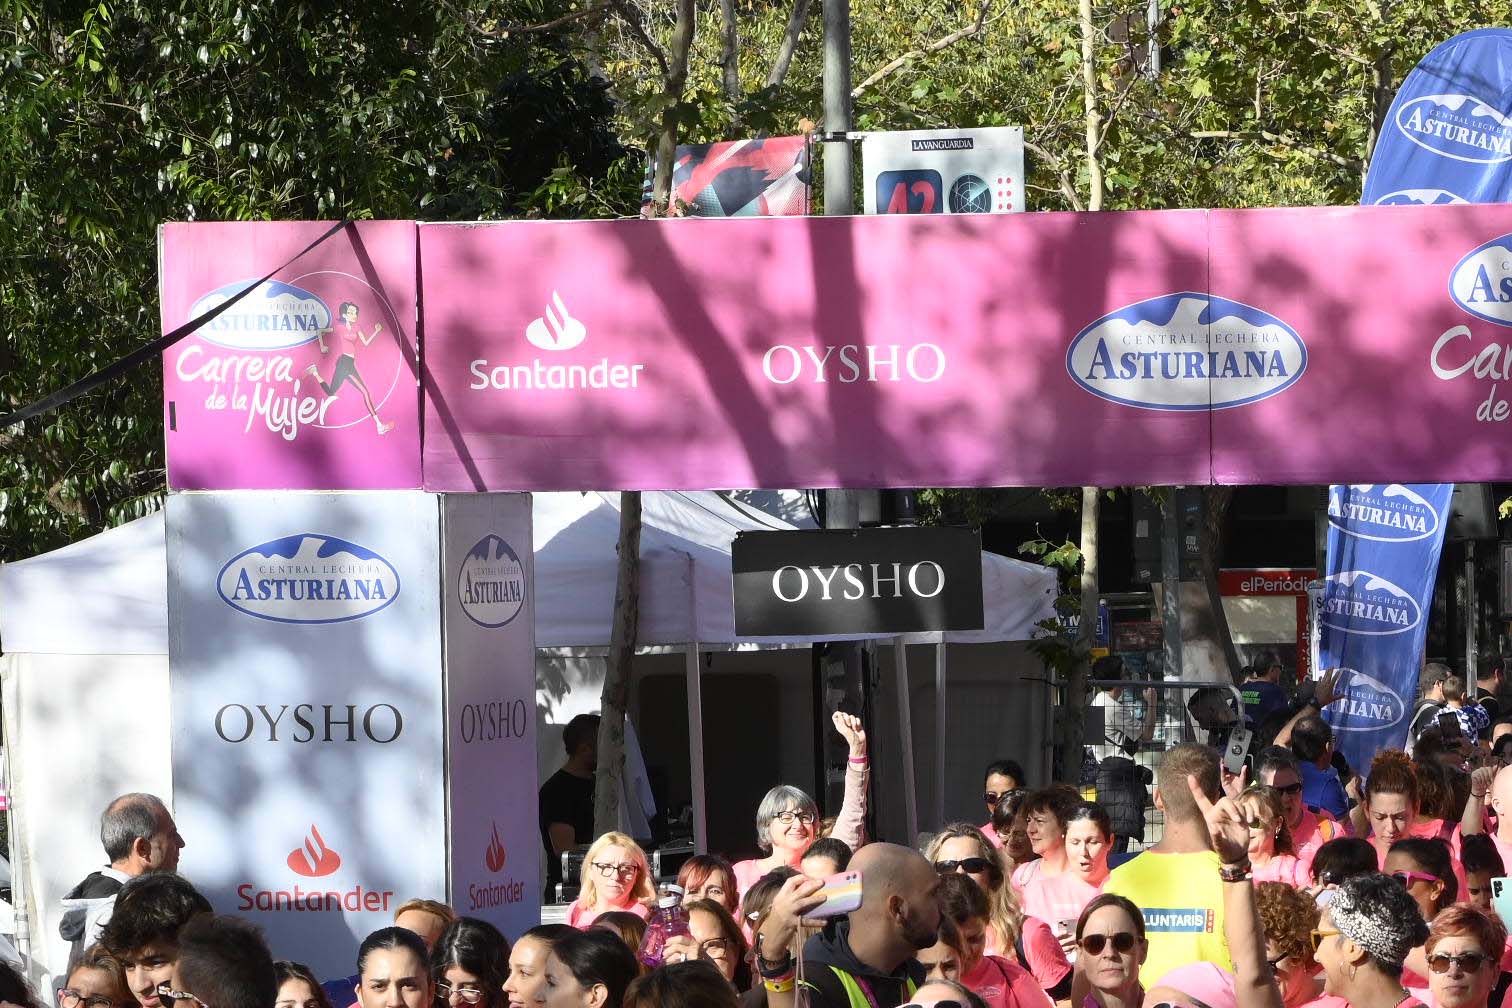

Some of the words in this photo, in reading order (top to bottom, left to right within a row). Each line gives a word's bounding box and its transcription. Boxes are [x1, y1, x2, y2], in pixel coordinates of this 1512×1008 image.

[1404, 107, 1512, 155] ASTURIANA
[1428, 109, 1469, 125] CENTRAL
[1121, 332, 1198, 346] CENTRAL
[1205, 331, 1282, 345] LECHERA
[175, 344, 295, 383] Carrera
[470, 358, 644, 391] Santander
[762, 342, 947, 384] OYSHO
[1085, 337, 1289, 382] ASTURIANA
[205, 384, 227, 410] de
[231, 383, 247, 410] la
[245, 383, 340, 441] Mujer
[1476, 383, 1512, 423] de
[1328, 492, 1427, 534] ASTURIANA
[231, 567, 387, 601] ASTURIANA
[258, 564, 318, 574] CENTRAL
[322, 563, 381, 574] LECHERA
[463, 569, 522, 604] ASTURIANA
[772, 560, 946, 603] OYSHO
[1324, 597, 1409, 627] STURIANA
[213, 703, 404, 745] OYSHO
[460, 699, 527, 744] OYSHO
[237, 883, 395, 914] Santander
[468, 880, 525, 912] Santander
[1143, 914, 1204, 927] LUNTARIS
